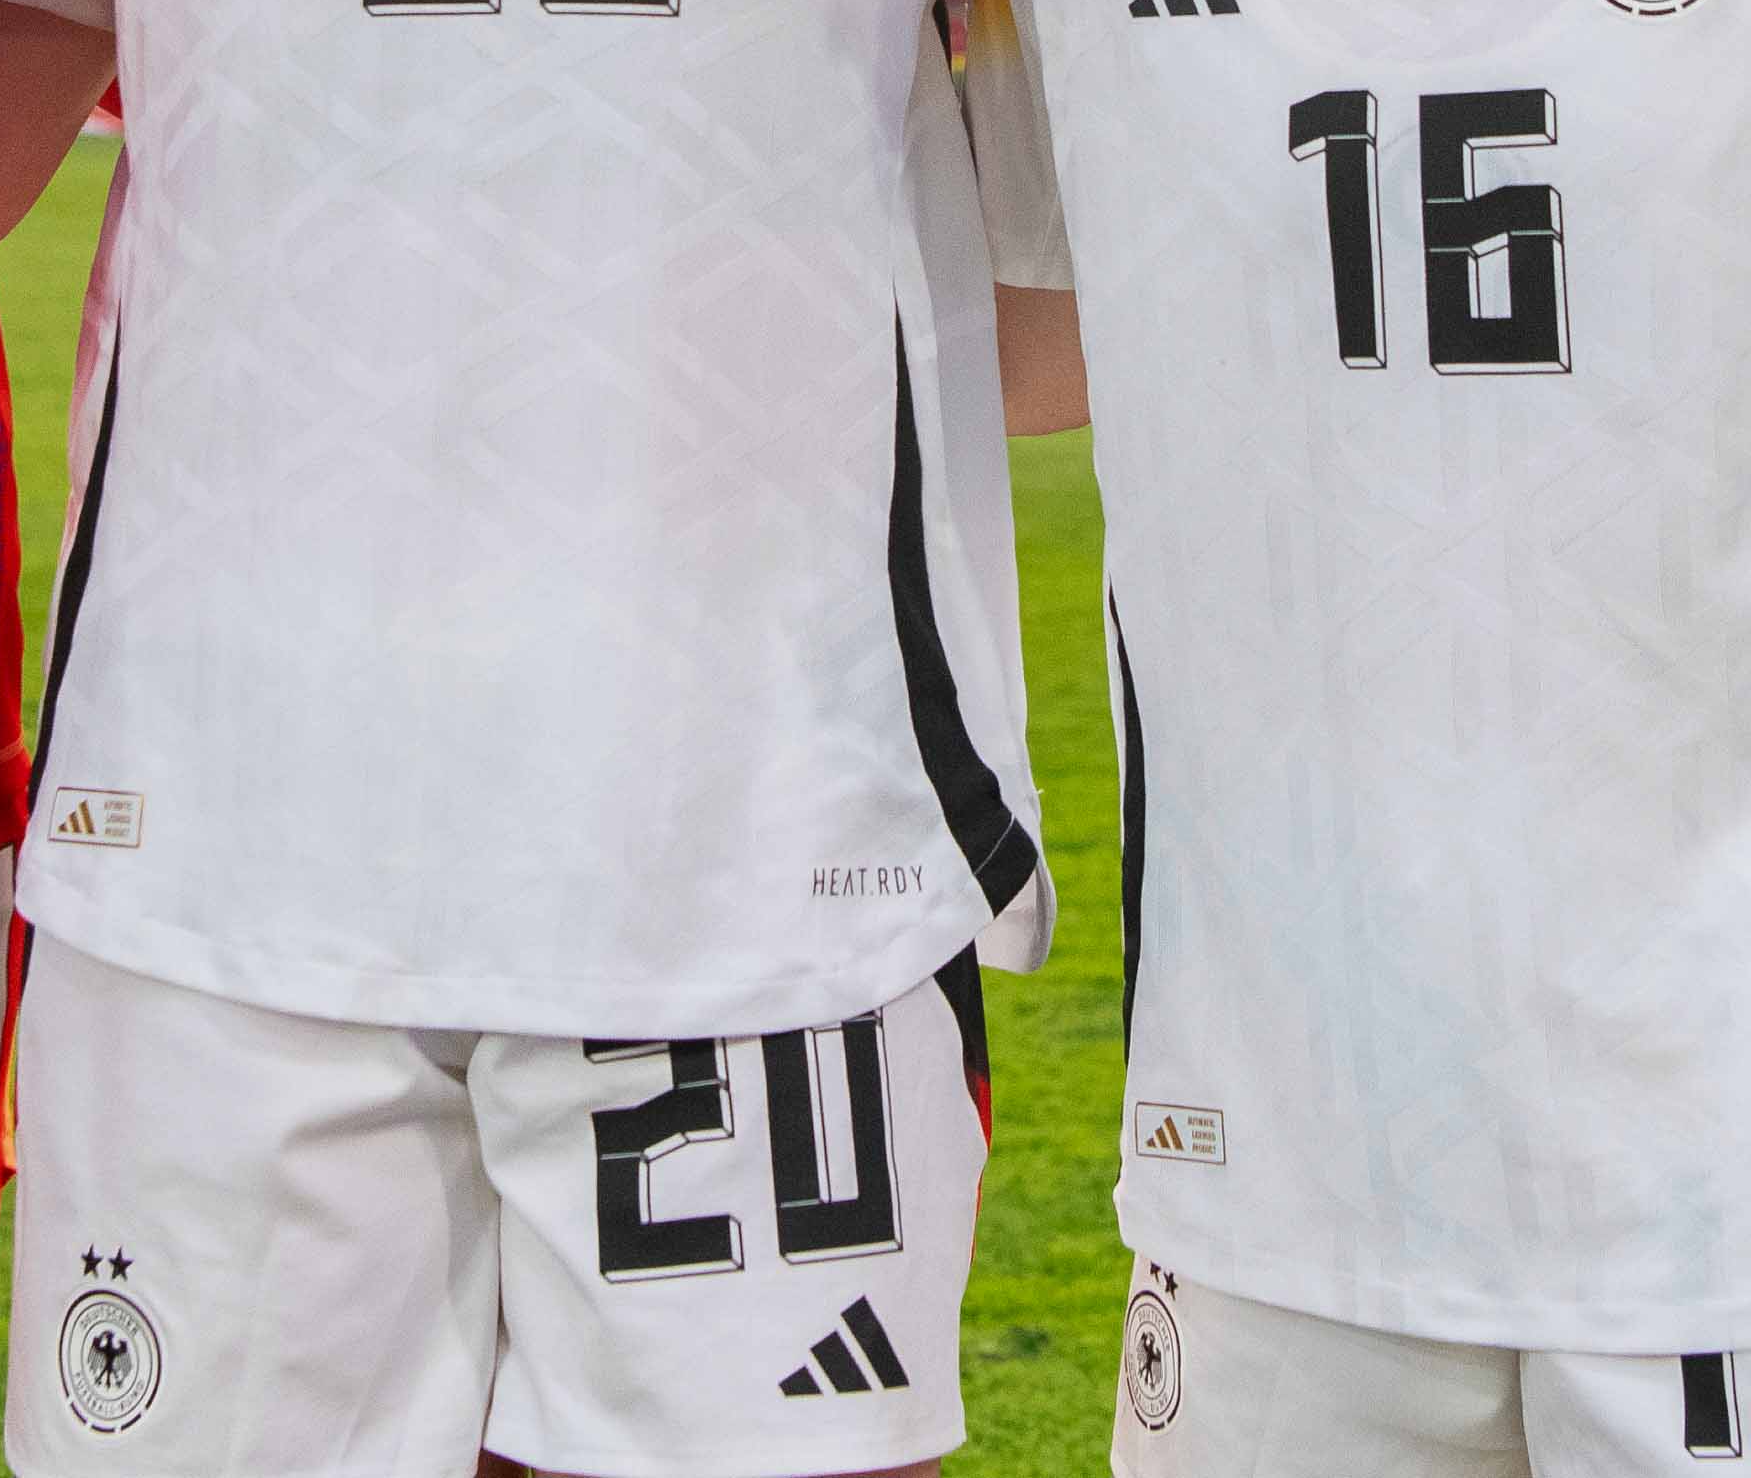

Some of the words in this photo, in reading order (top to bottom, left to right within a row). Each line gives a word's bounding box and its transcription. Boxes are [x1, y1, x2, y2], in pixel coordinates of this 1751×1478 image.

[1289, 88, 1572, 375] 16
[812, 865, 923, 897] HEAT.RDY
[583, 1007, 903, 1284] 20
